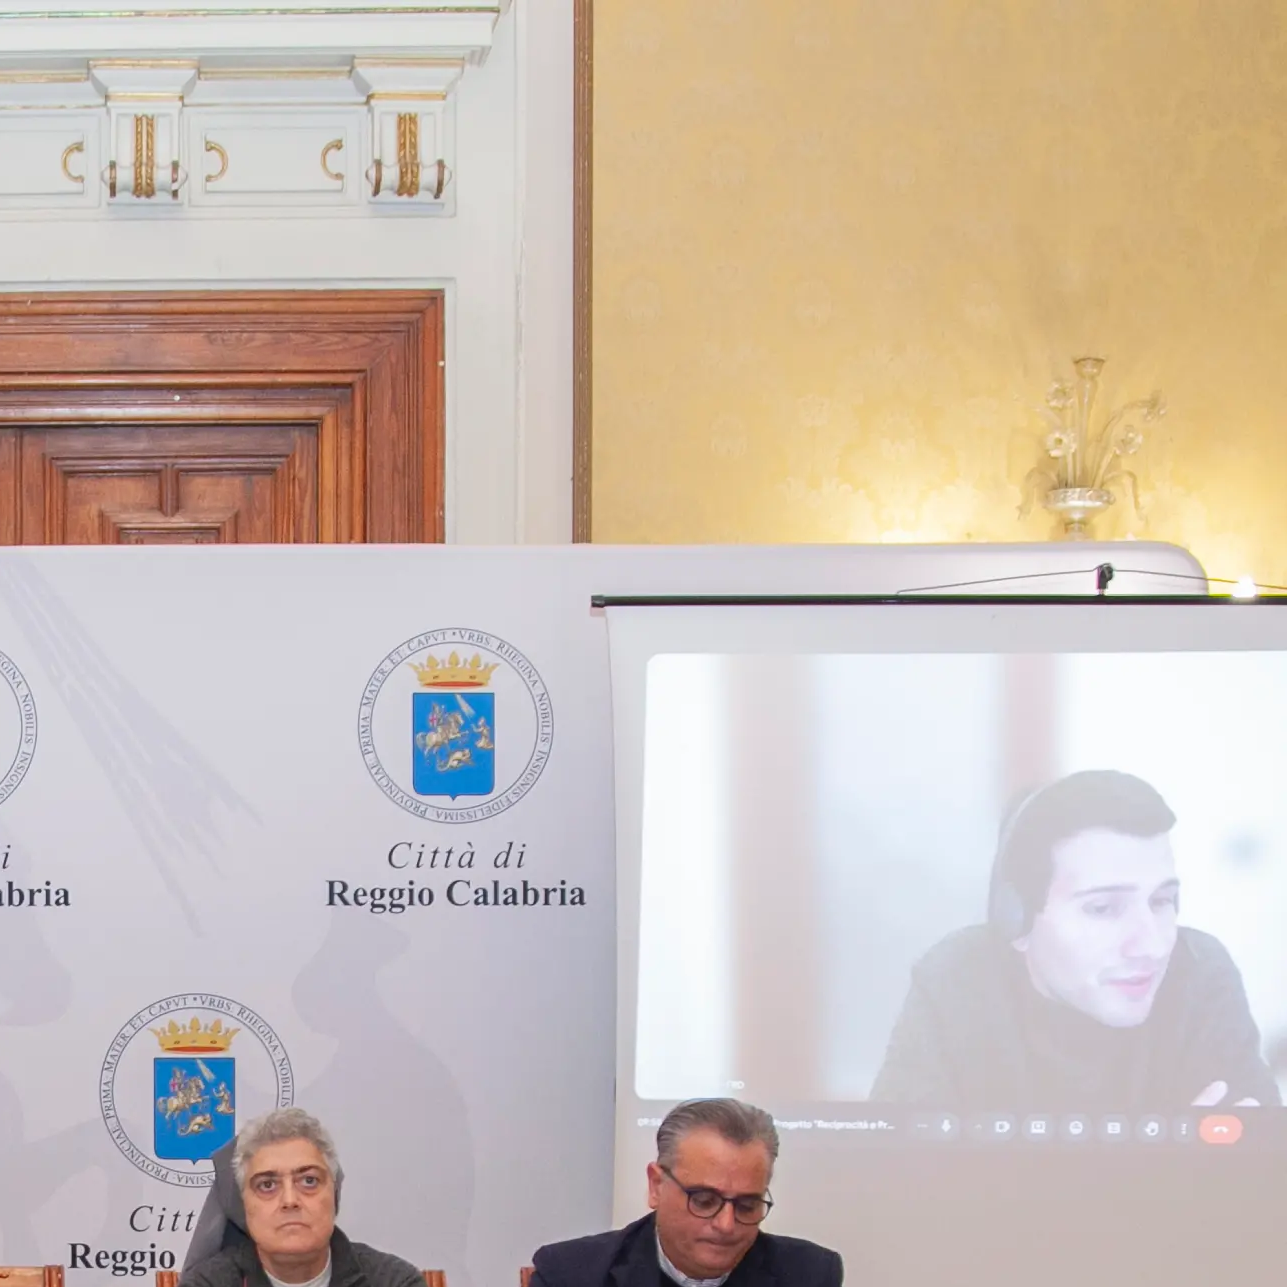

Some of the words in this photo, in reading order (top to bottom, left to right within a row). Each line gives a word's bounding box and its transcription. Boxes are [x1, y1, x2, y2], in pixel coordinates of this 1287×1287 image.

[388, 842, 475, 869] Città
[494, 842, 526, 868] di
[326, 880, 434, 913] Reggio
[446, 879, 586, 906] Calabria
[129, 1205, 197, 1232] Citt
[68, 1242, 175, 1276] Reggio
